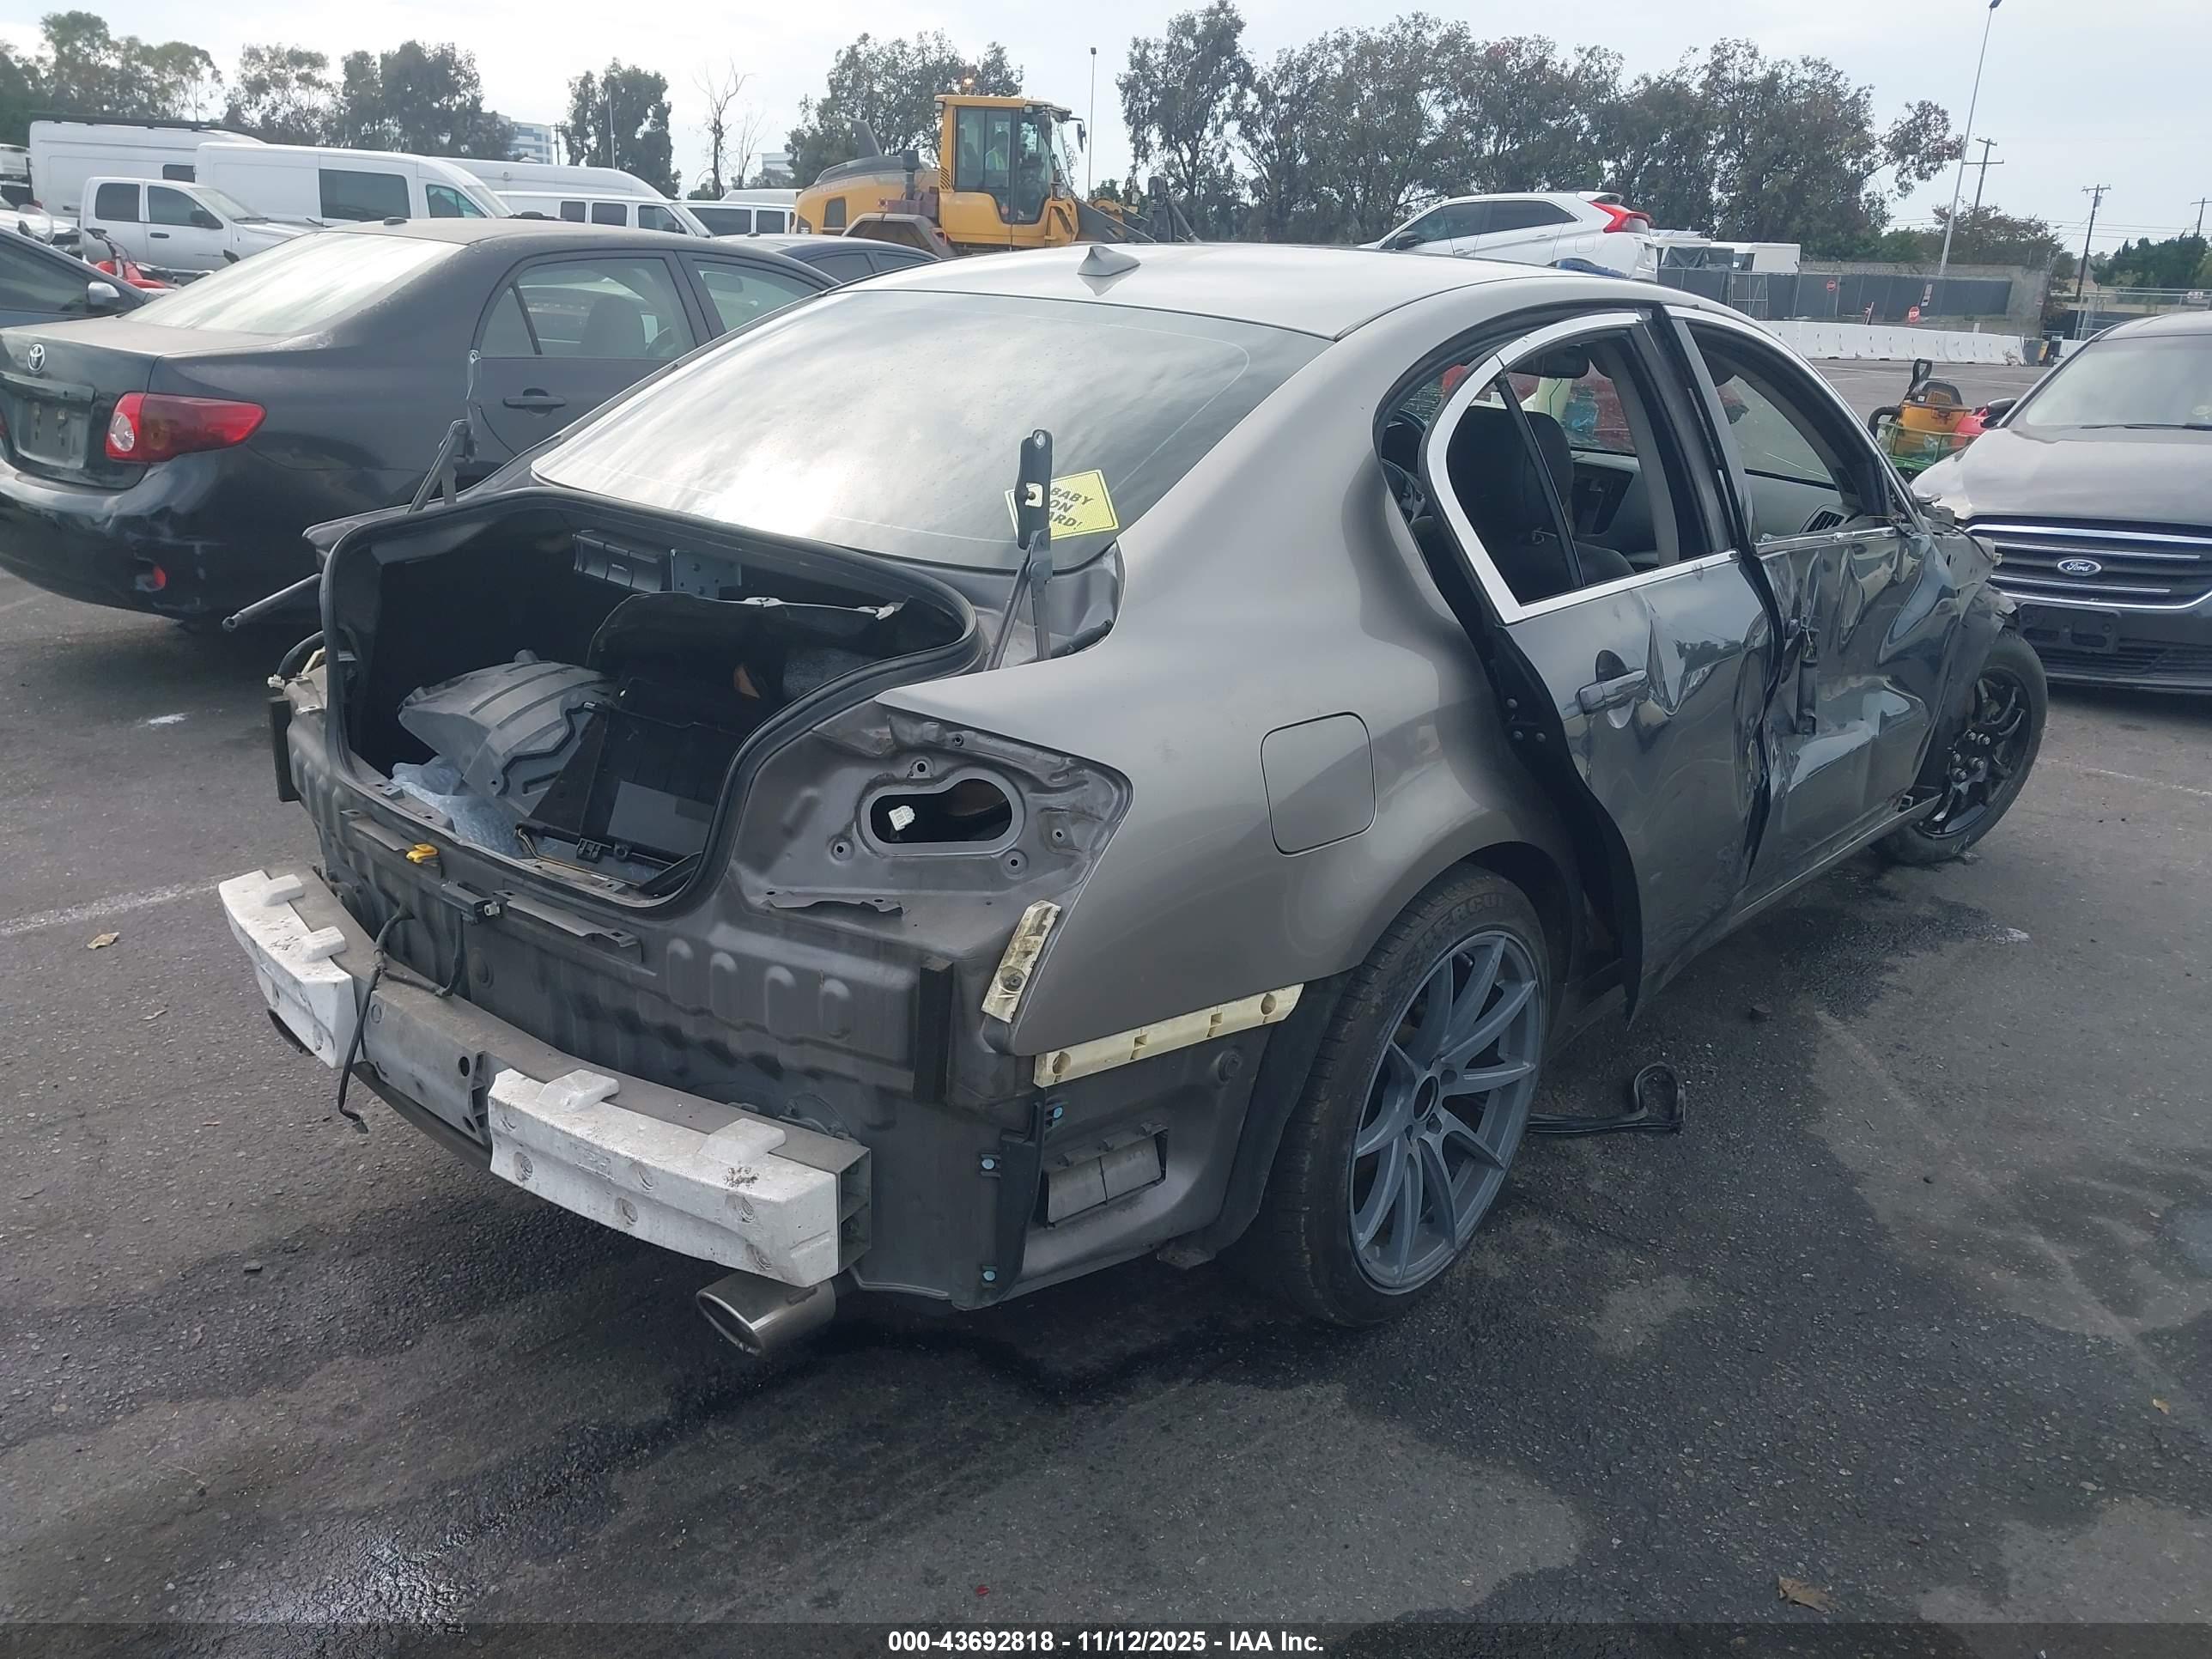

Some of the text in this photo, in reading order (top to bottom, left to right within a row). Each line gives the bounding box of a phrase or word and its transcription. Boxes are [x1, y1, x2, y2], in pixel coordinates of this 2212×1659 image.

[1050, 487, 1095, 505] BABY
[1049, 499, 1074, 513] ON
[1049, 511, 1083, 531] ARD!
[2067, 562, 2091, 572] Ford
